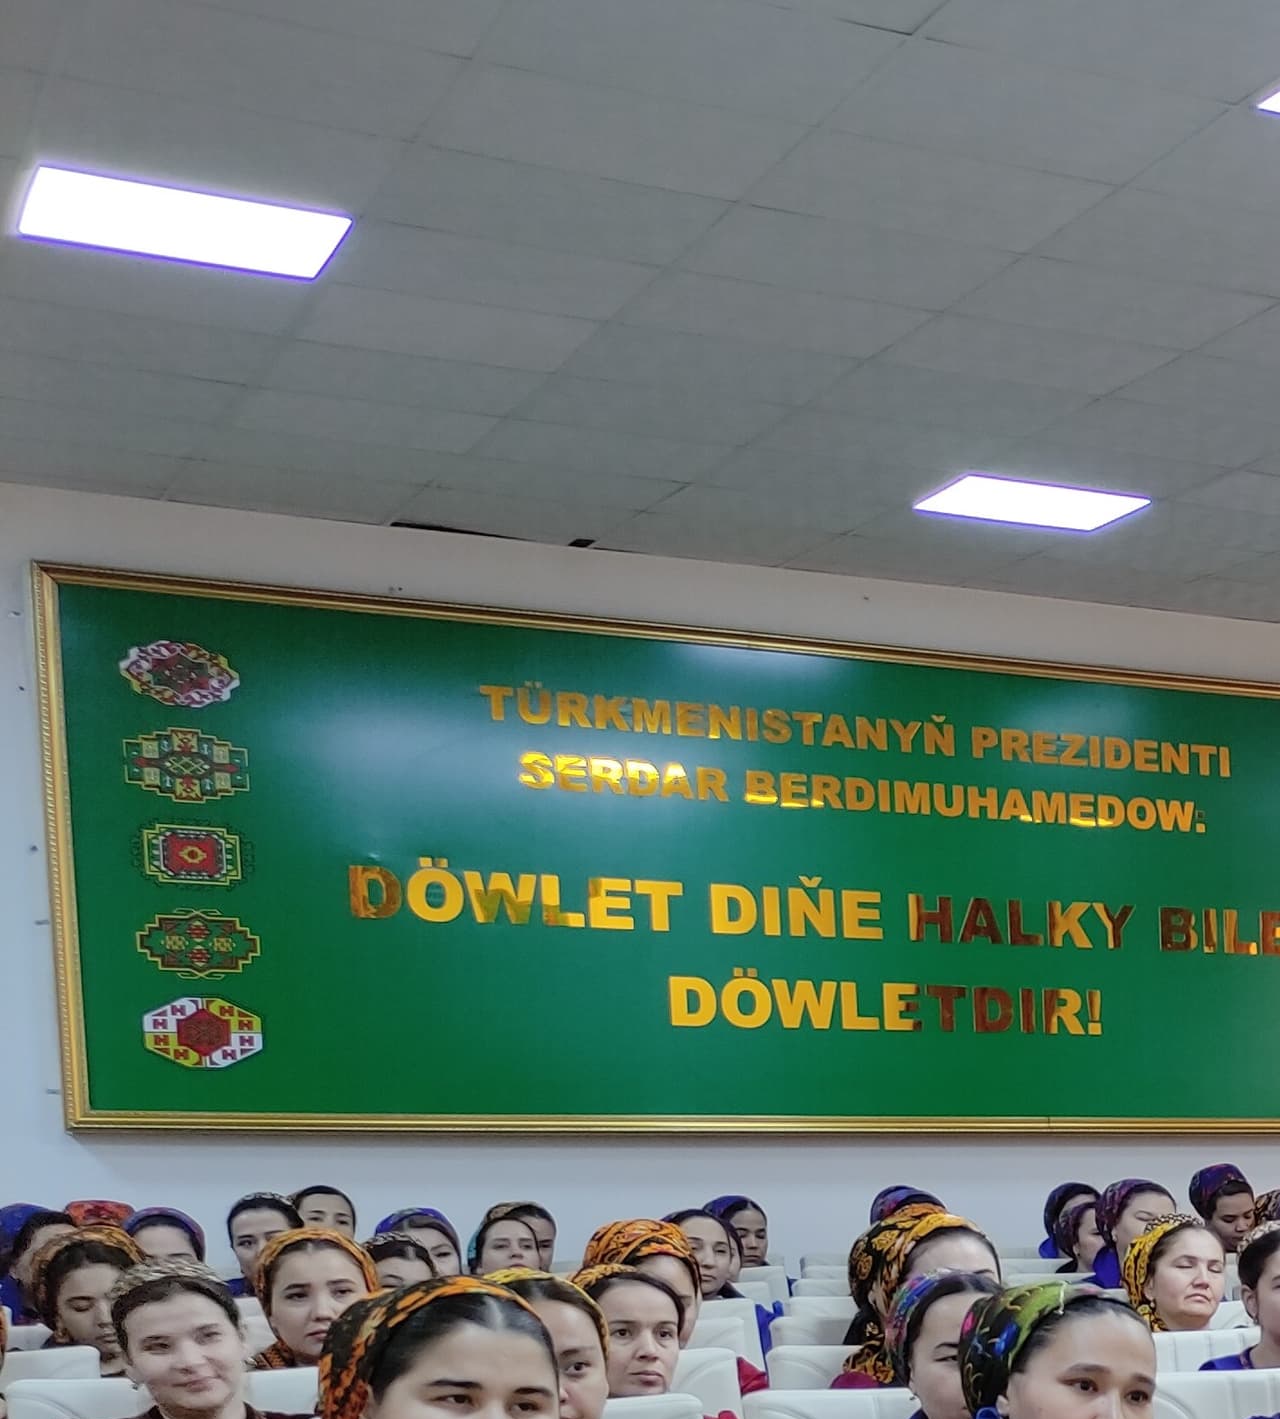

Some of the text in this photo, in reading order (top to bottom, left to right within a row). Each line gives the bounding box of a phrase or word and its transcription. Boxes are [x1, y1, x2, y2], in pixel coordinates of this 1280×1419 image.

[479, 680, 1231, 778] TÜRKMENISTANYŇ PREZIDENTI
[519, 751, 1206, 833] SERDAR BERDIMUHAMEDOW:
[349, 857, 683, 931] DÖWLET
[710, 875, 883, 940] DIŇE
[908, 892, 1136, 950] HALKY
[668, 967, 1102, 1036] DÖWLETDIR!
